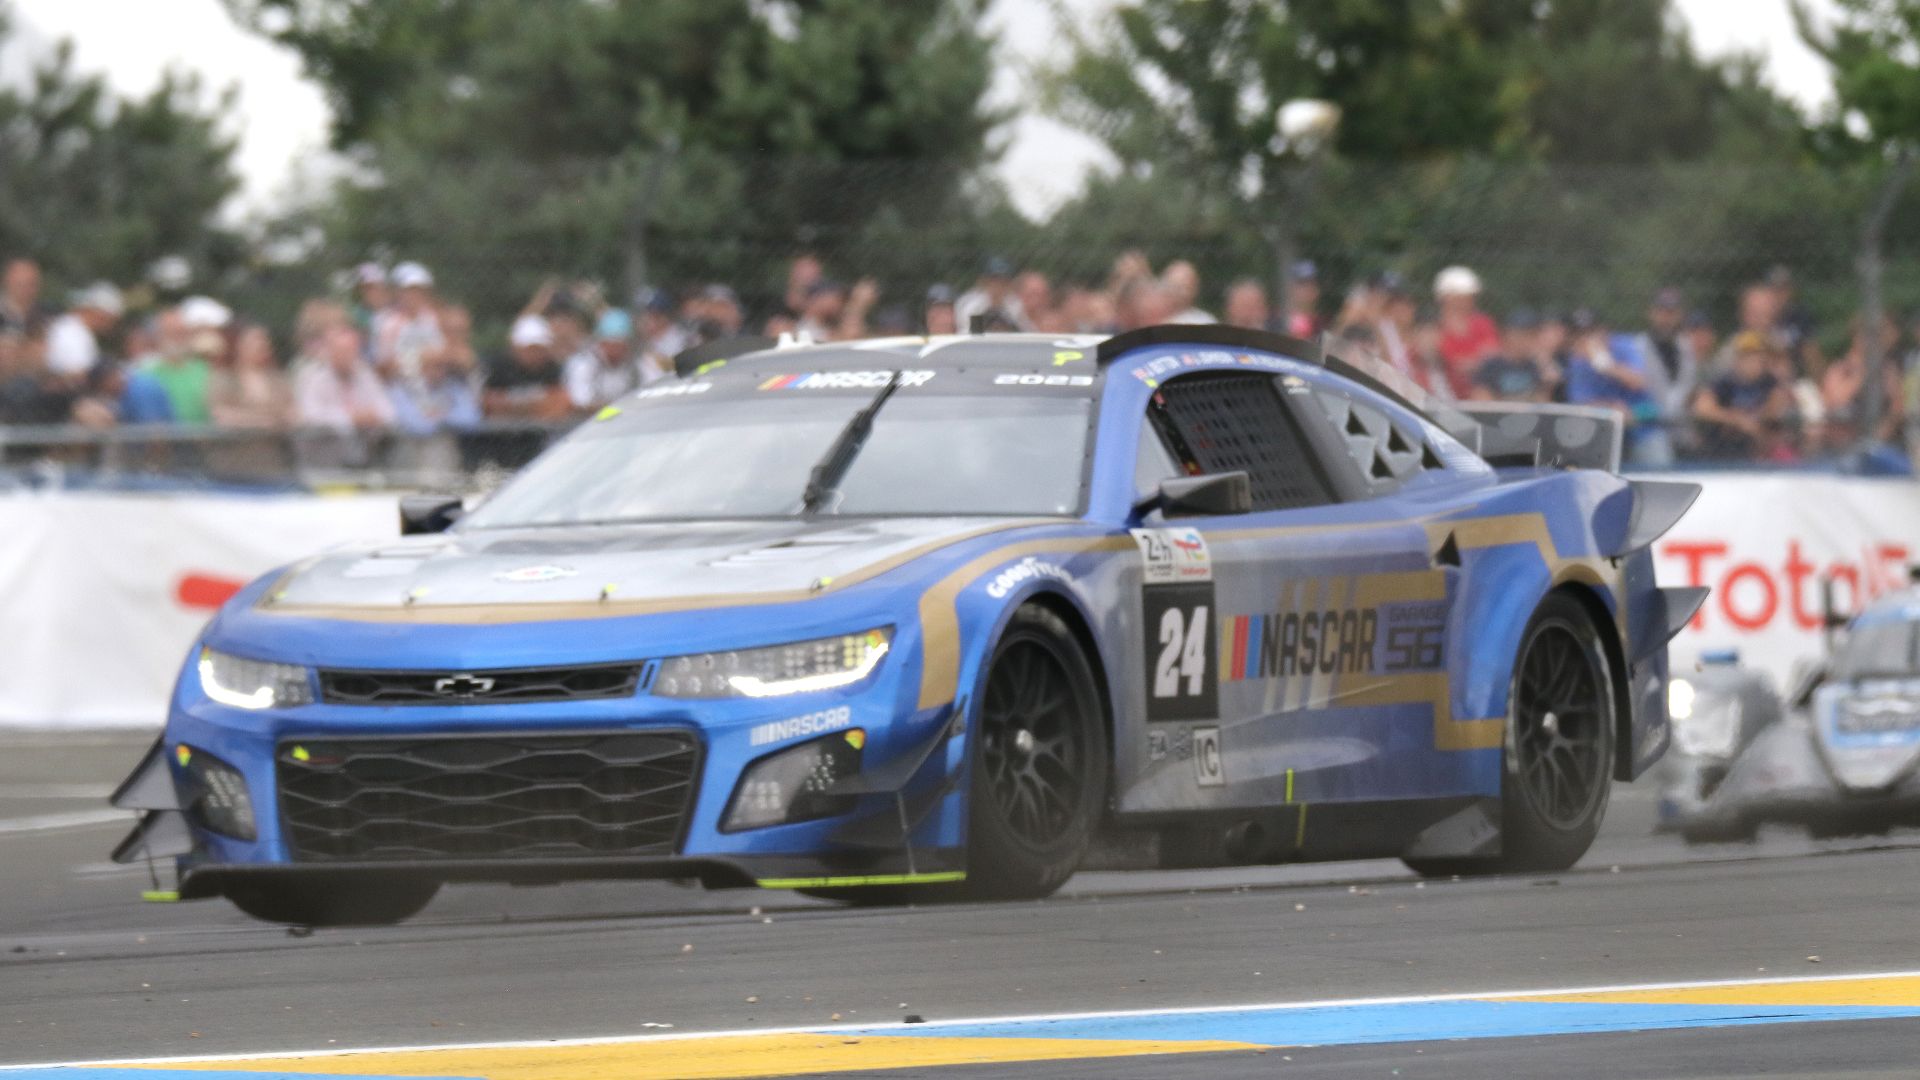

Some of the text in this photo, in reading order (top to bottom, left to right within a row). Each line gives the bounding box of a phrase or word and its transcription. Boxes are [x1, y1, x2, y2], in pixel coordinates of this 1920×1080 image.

[797, 370, 936, 389] NASCAR
[994, 374, 1094, 386] 2023
[1154, 606, 1208, 698] 24
[1259, 608, 1377, 679] NASCAR
[1385, 625, 1445, 669] 56
[772, 705, 850, 741] NASCAR
